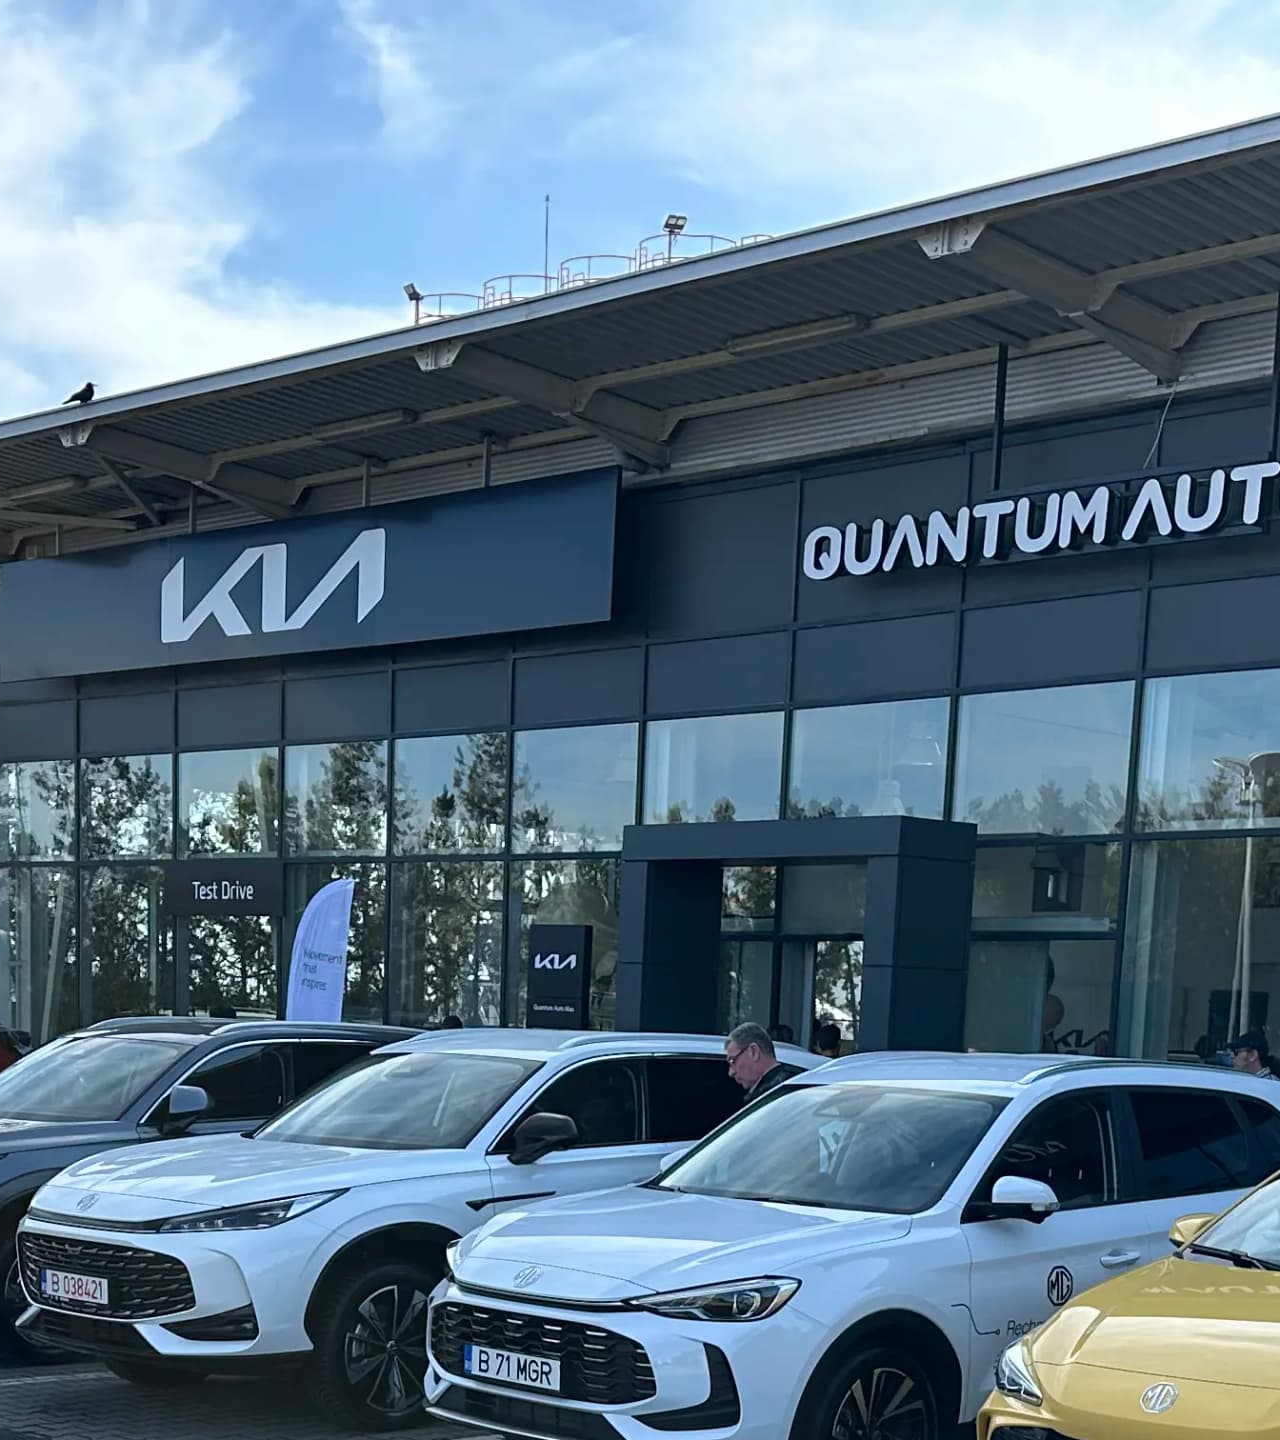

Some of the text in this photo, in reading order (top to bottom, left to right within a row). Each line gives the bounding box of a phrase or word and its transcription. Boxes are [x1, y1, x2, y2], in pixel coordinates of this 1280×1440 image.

[802, 486, 1109, 580] QUANTUM
[161, 527, 386, 643] KIA
[191, 880, 255, 900] Test Drive
[534, 952, 577, 970] KIA
[51, 1273, 60, 1293] B
[63, 1275, 103, 1300] 038421
[1049, 1270, 1070, 1302] MG
[1006, 1318, 1045, 1336] Rech
[478, 1350, 490, 1373] B
[495, 1353, 511, 1377] 71
[516, 1356, 552, 1386] MGR
[1142, 1384, 1176, 1410] MG
